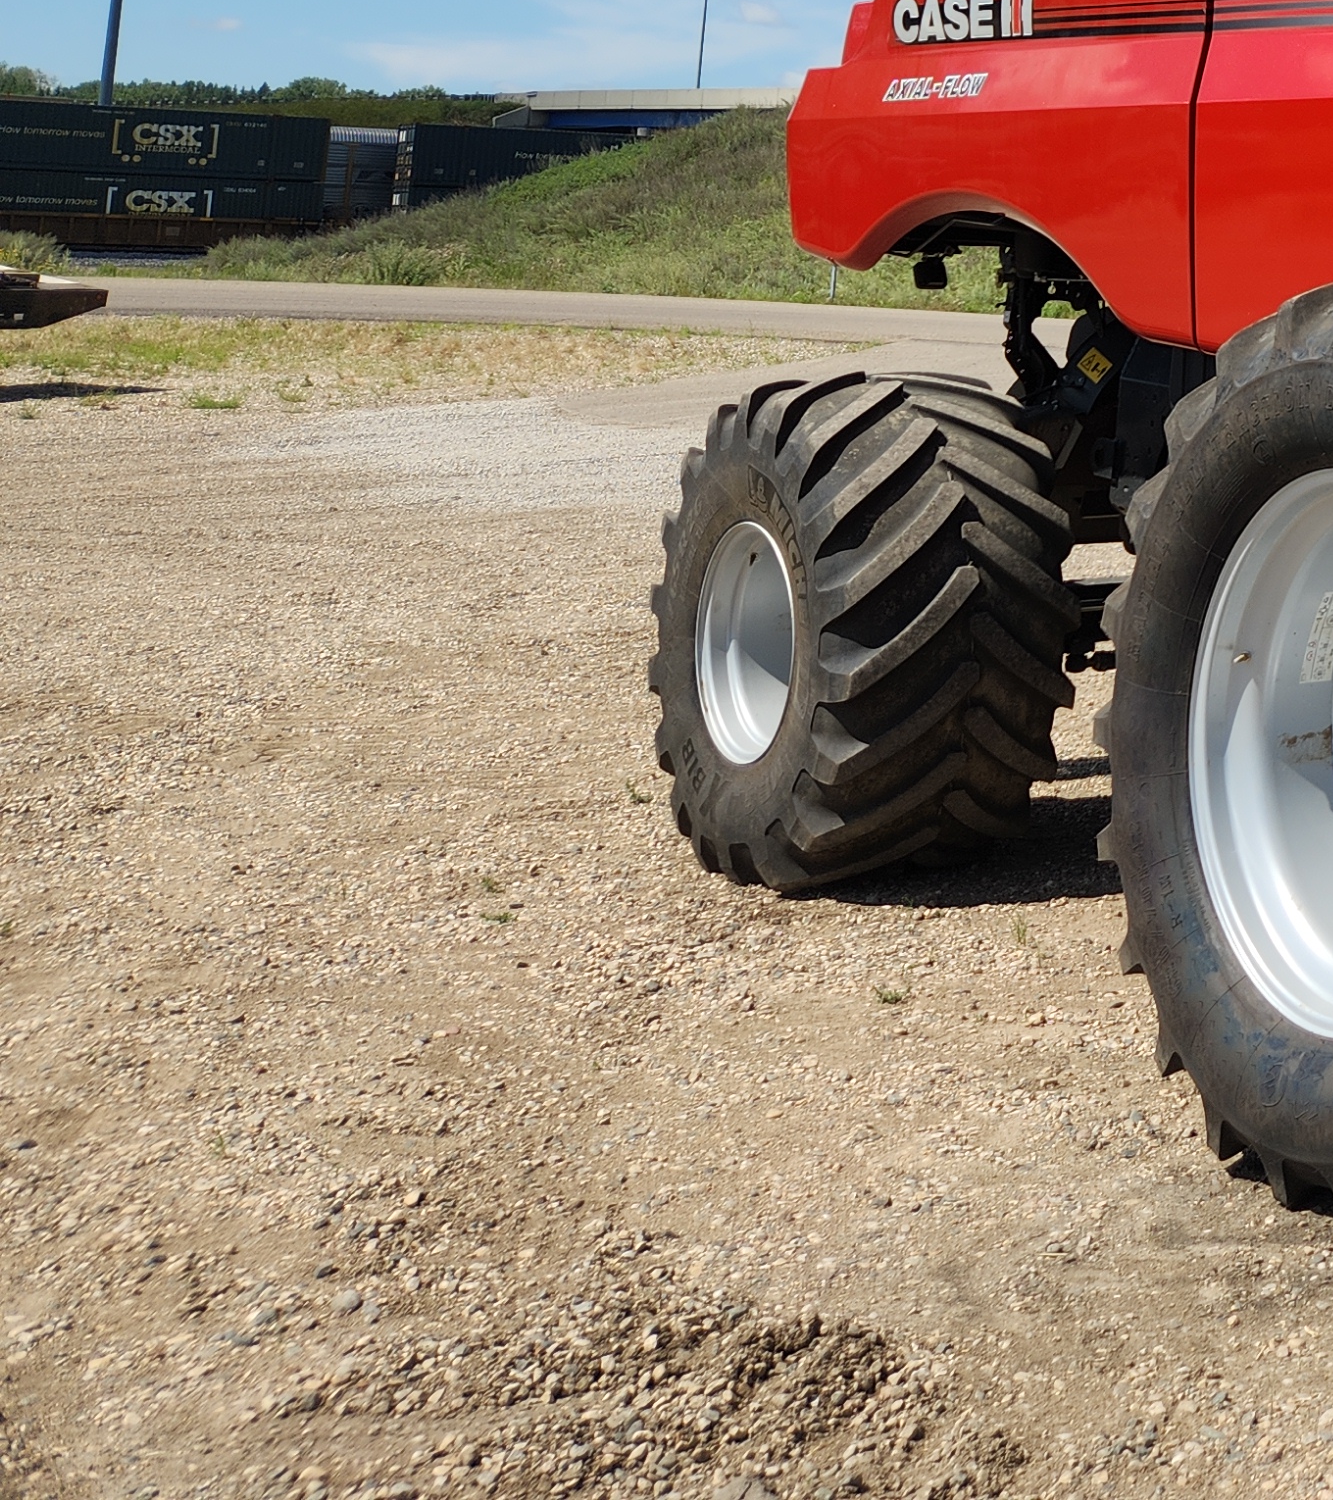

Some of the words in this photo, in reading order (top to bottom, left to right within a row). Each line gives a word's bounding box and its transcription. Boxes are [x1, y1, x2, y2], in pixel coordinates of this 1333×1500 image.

[882, 72, 989, 102] AXIAL-FLOW
[23, 126, 70, 136] tomorrow
[72, 130, 105, 138] moves
[132, 122, 203, 147] CSX
[16, 195, 64, 205] tomorrow
[65, 197, 98, 206] moves
[125, 189, 196, 213] CSX
